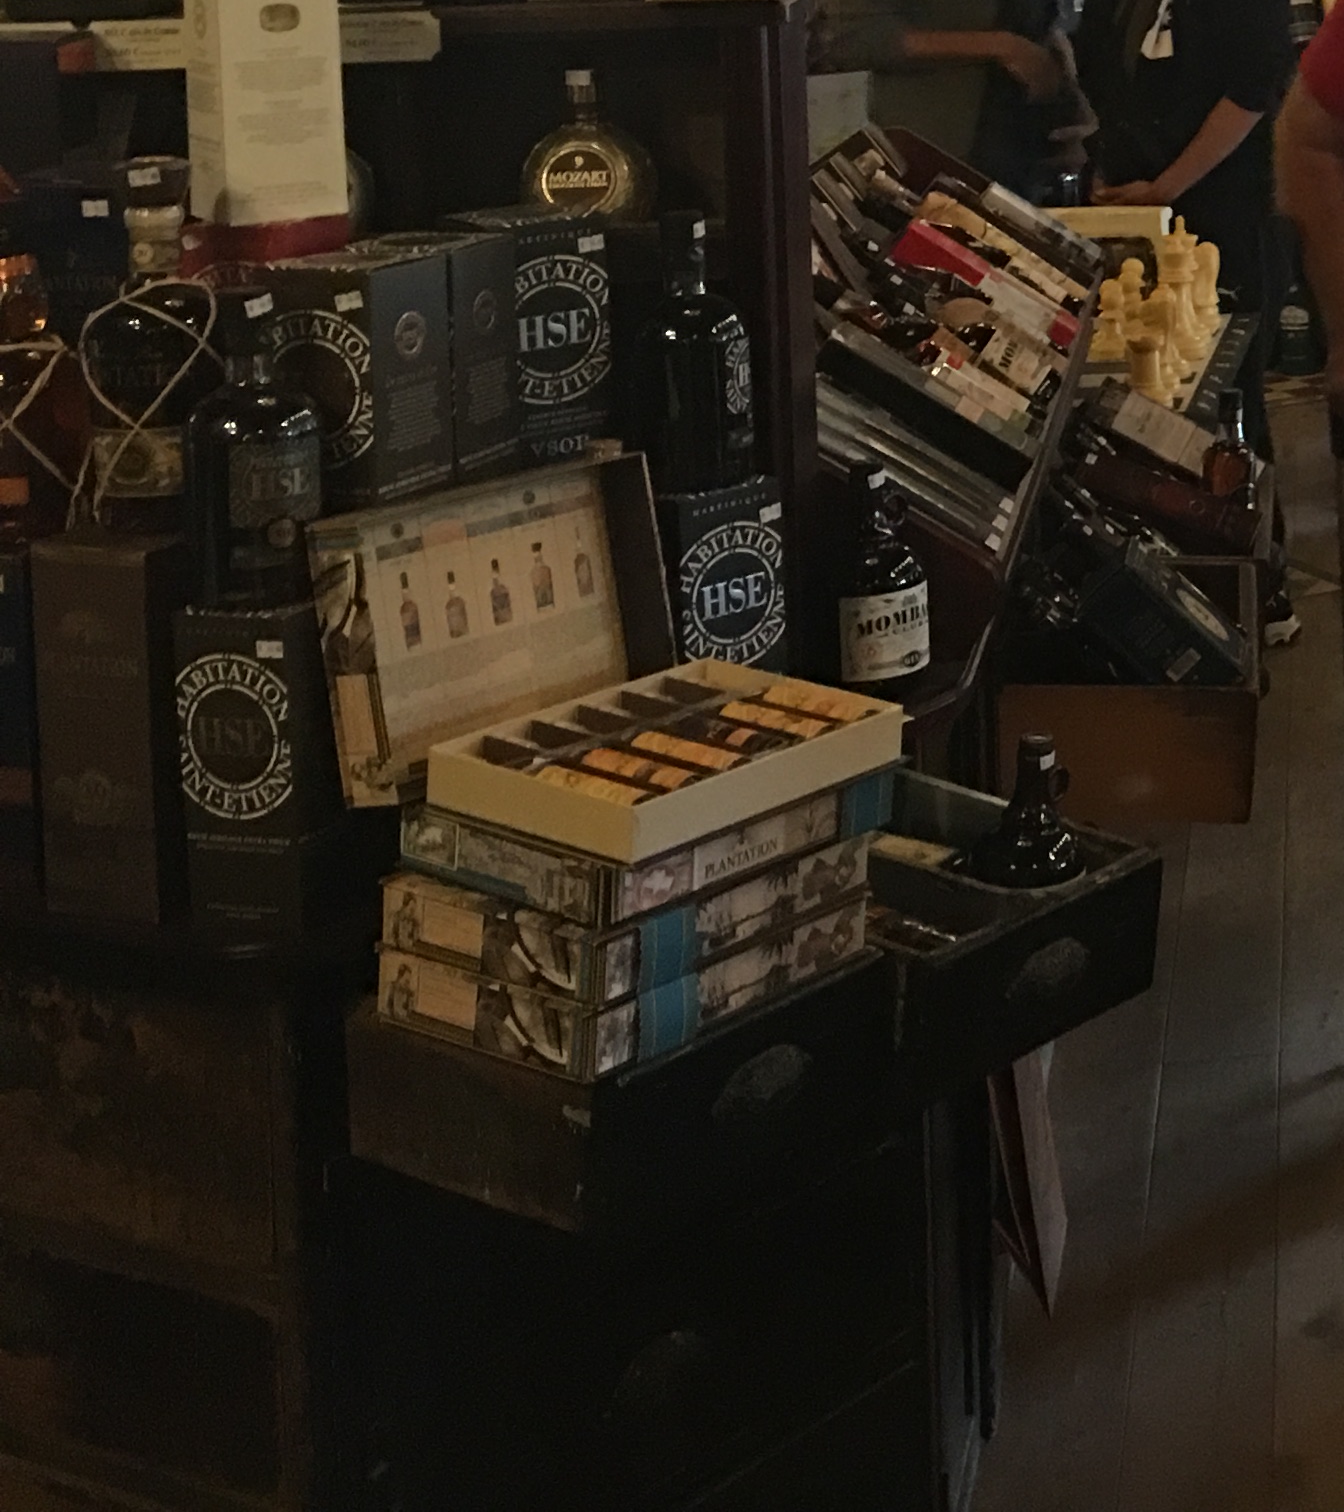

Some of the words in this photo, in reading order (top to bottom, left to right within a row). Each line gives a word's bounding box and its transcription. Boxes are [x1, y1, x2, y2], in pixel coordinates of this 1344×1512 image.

[549, 170, 609, 183] MOZART
[513, 261, 610, 306] BITATION
[517, 308, 592, 353] HSE
[680, 528, 783, 594] HABITATION
[701, 571, 768, 622] HSE
[857, 603, 927, 637] MOMBA
[177, 662, 290, 721] HABITATION
[704, 838, 778, 879] PLANTATION
